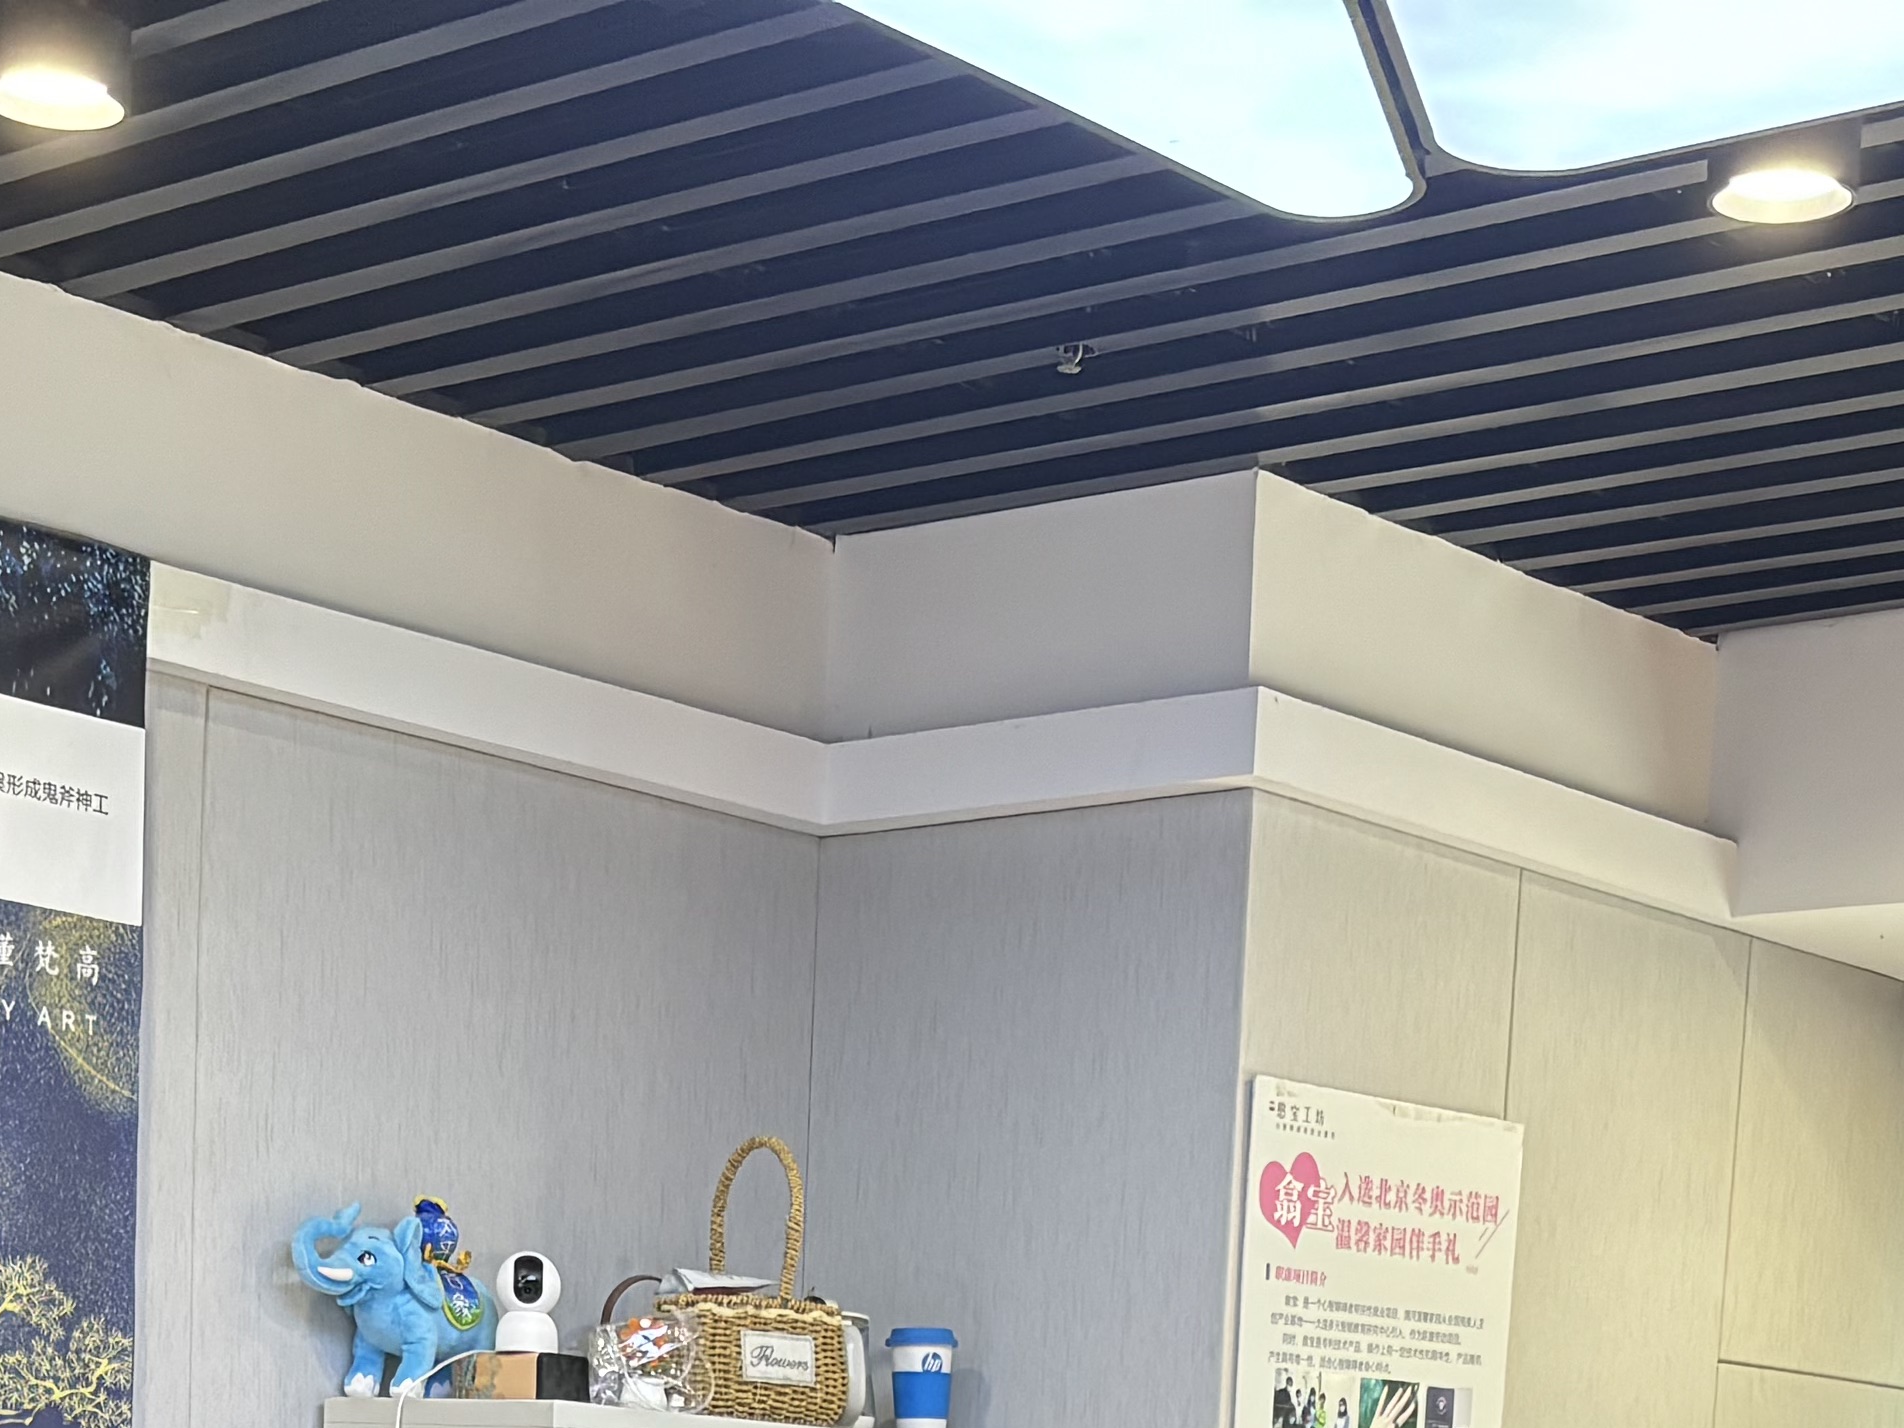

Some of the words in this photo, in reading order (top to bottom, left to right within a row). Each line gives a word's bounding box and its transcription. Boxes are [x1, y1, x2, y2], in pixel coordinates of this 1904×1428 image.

[37, 1005, 98, 1037] ART
[1272, 1172, 1336, 1232] 翕宝
[1335, 1217, 1461, 1265] 温馨家园伴手礼
[749, 1344, 810, 1372] Flowers
[924, 1353, 943, 1373] hp
